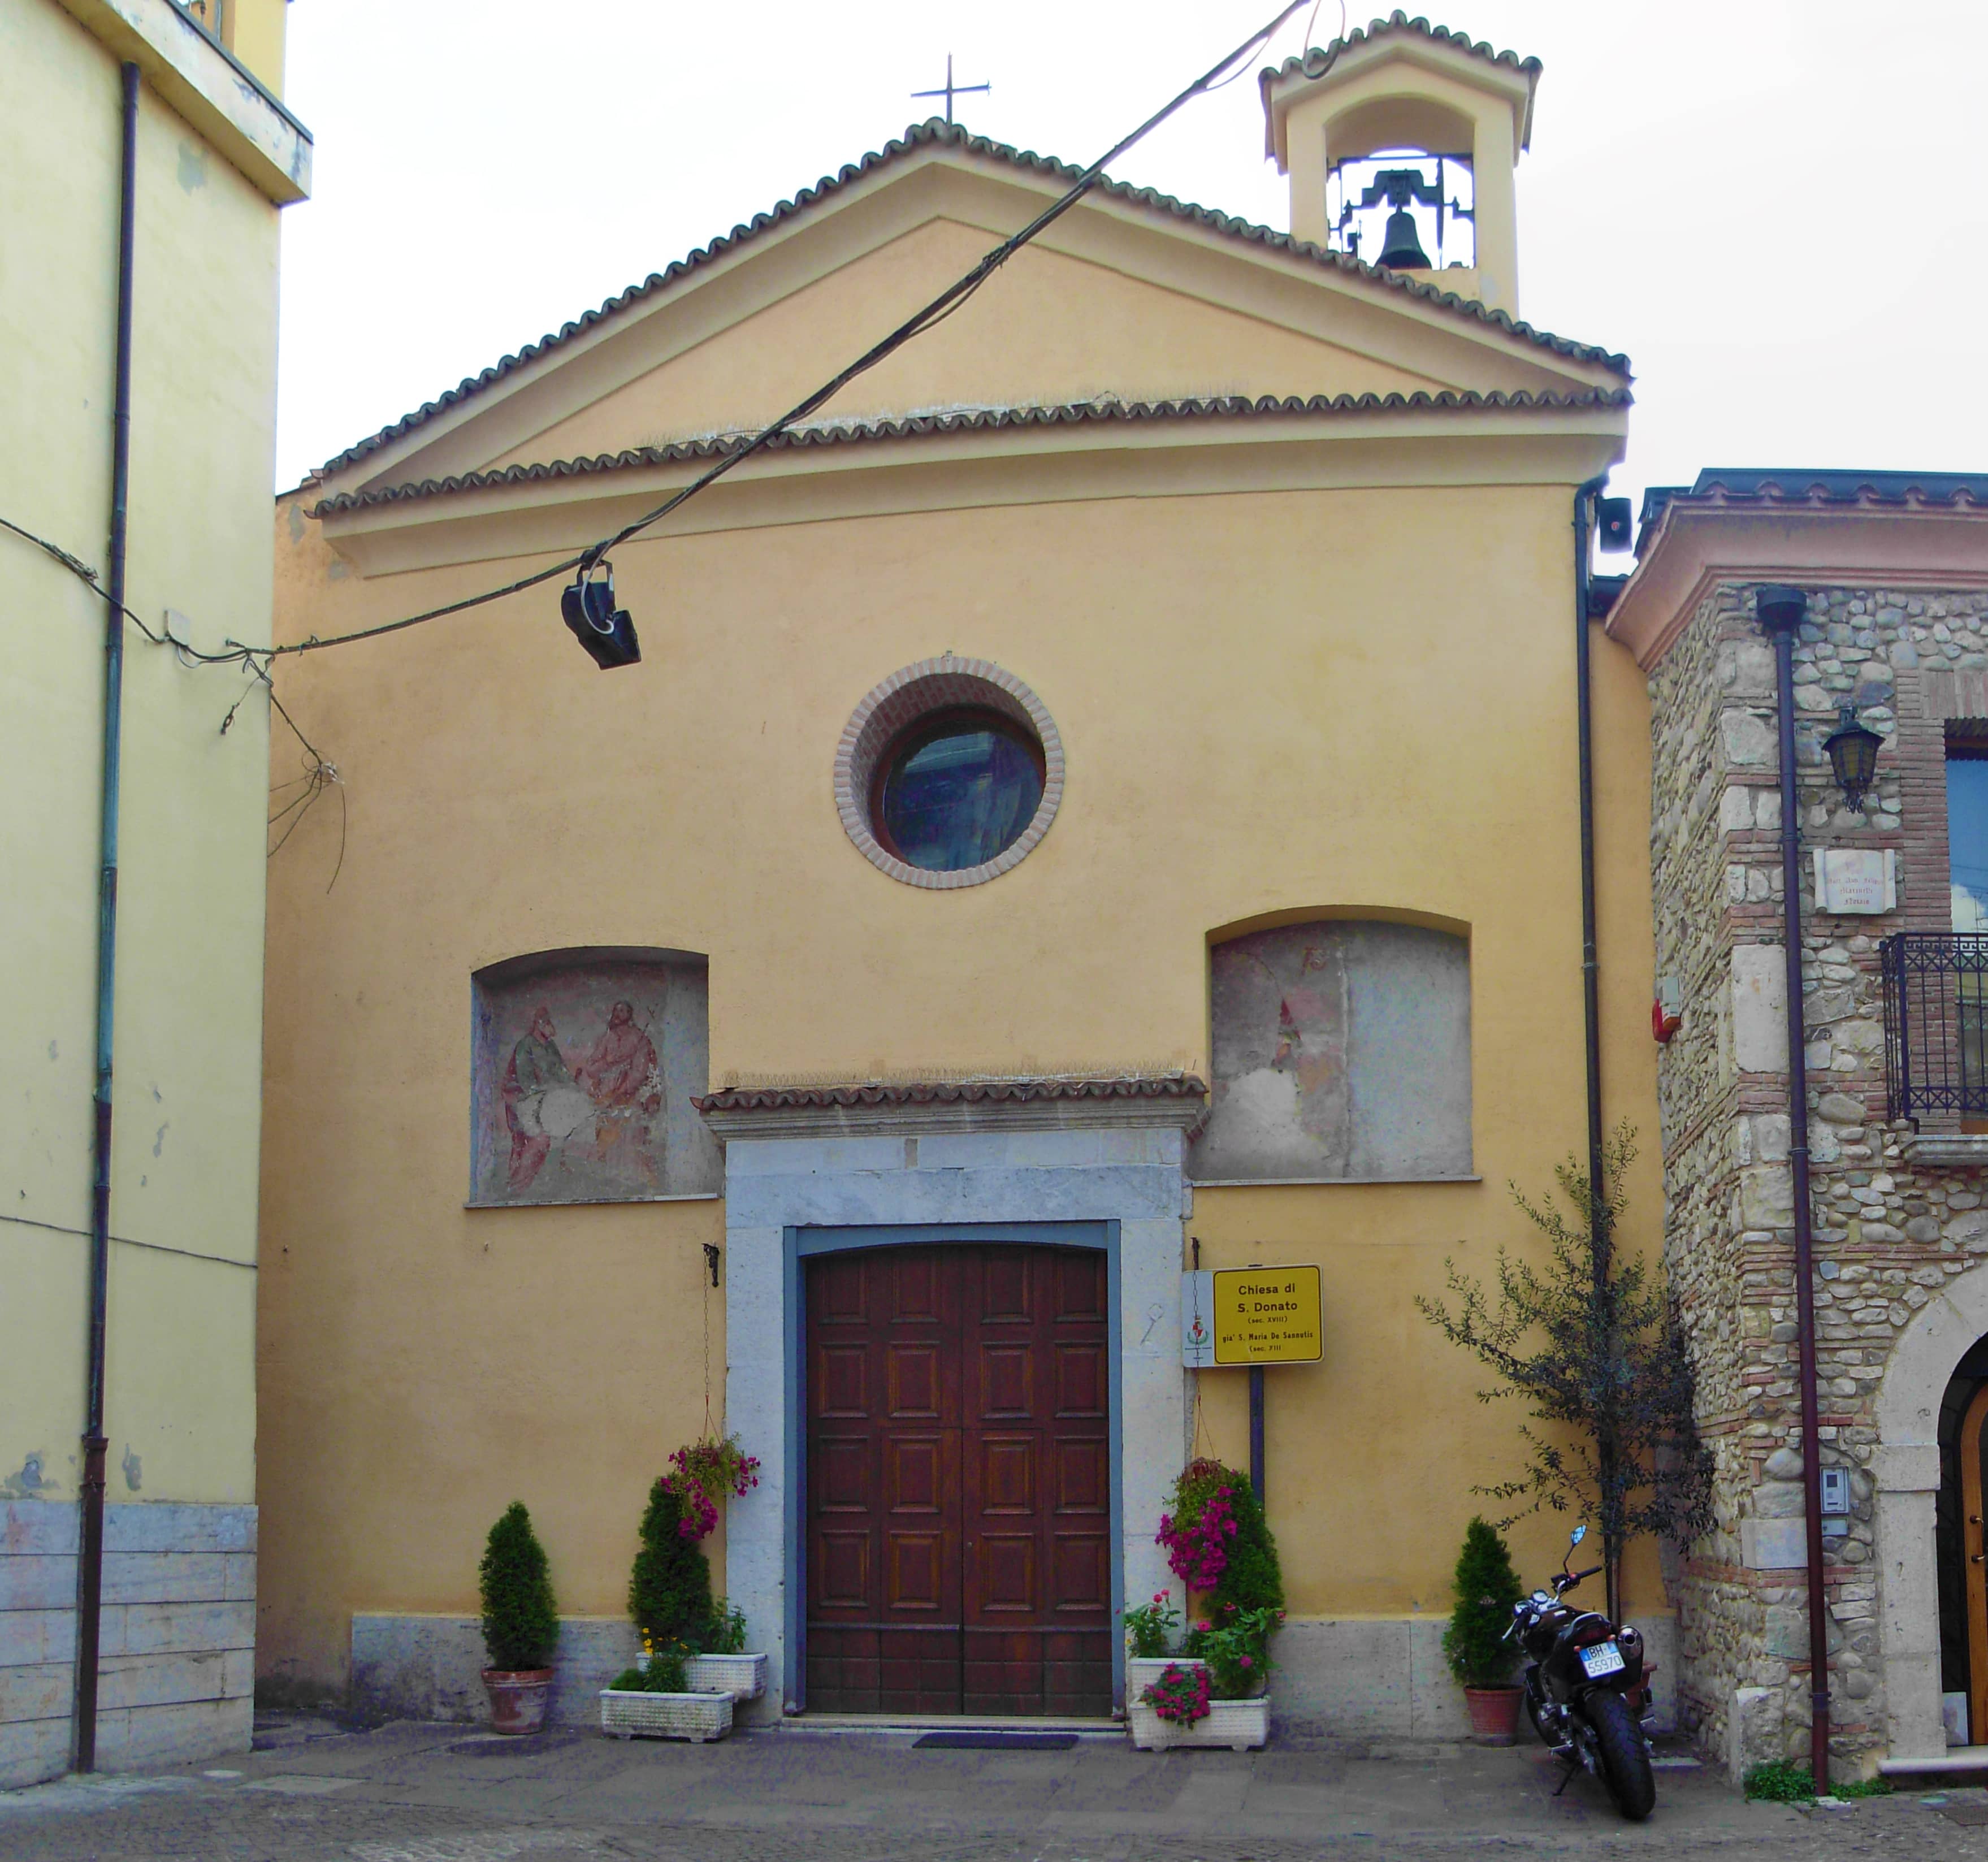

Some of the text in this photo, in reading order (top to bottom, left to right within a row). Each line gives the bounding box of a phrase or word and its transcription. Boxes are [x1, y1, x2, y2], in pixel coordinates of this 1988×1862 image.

[1238, 1283, 1296, 1295] Chiesa di
[1237, 1301, 1298, 1313] S. Donato
[1588, 1645, 1604, 1659] BH
[1588, 1655, 1622, 1674] 55970
